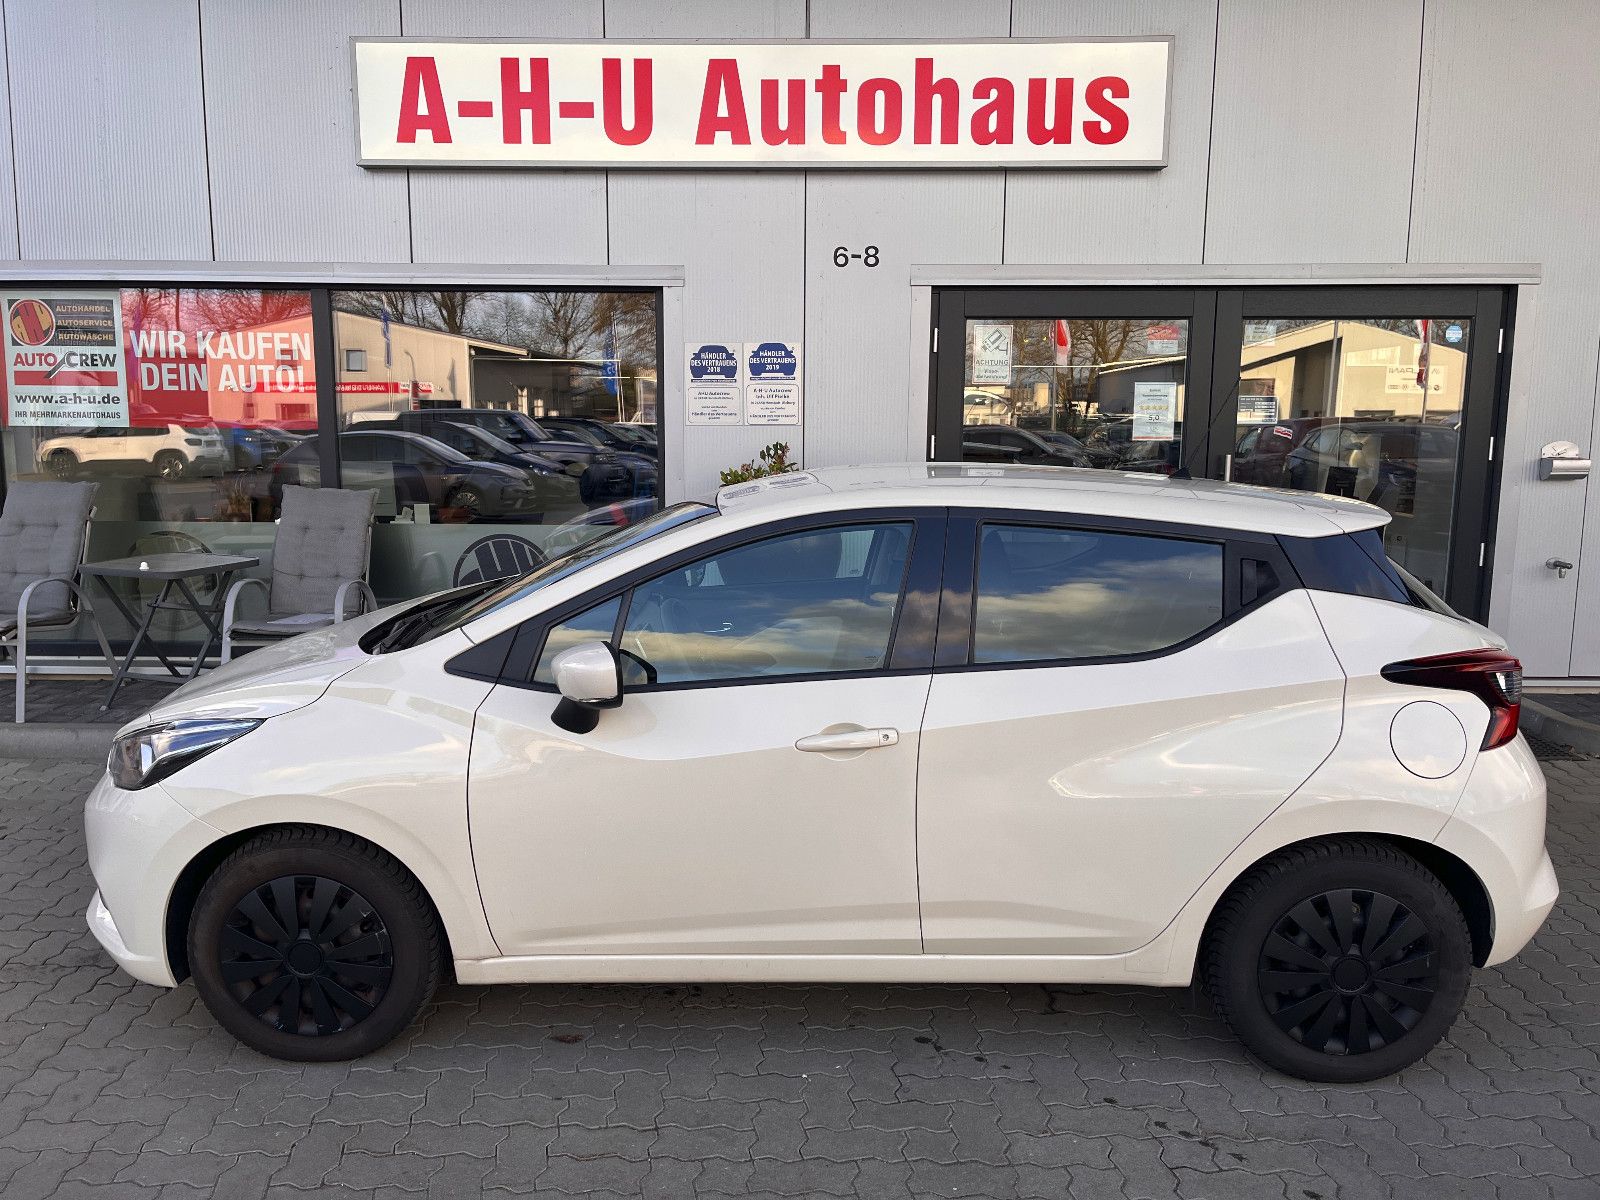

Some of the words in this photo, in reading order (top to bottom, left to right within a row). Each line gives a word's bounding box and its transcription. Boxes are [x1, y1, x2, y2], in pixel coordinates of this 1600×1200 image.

[397, 57, 653, 146] A-H-U
[696, 58, 1129, 146] Autohaus
[833, 245, 880, 268] 6-8
[56, 319, 113, 327] AUTOSERVICE
[129, 330, 187, 358] WIR
[196, 331, 311, 360] KAUFEN
[14, 352, 57, 366] AUTO
[65, 351, 116, 368] CREW
[140, 362, 208, 391] DEIN
[218, 364, 304, 393] AUTO!
[15, 393, 120, 404] www.a-h-u.de
[30, 411, 121, 419] MEHRMARKENAUTOHAUS
[1148, 414, 1160, 422] 5,0
